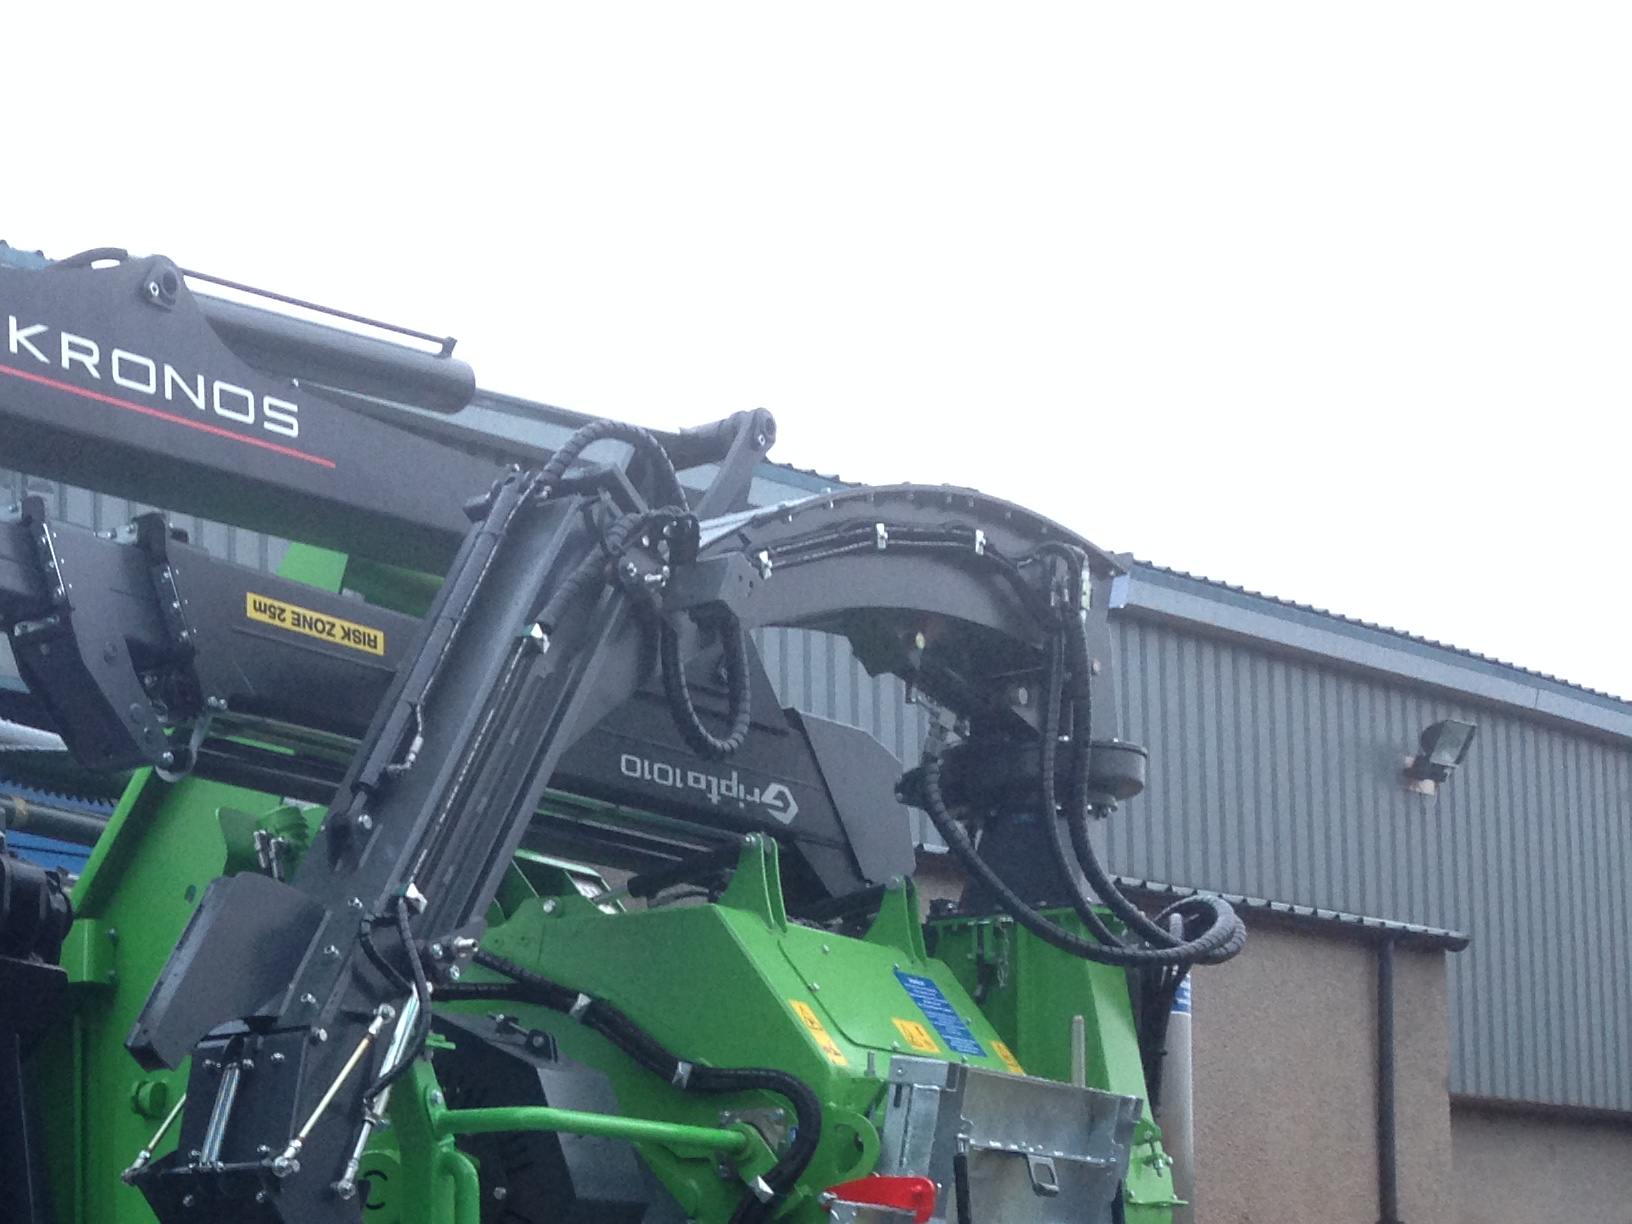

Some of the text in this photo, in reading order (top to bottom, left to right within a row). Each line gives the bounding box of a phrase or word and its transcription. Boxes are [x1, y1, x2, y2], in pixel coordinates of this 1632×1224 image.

[8, 315, 299, 437] KRONOS
[253, 599, 378, 649] RISK ZONE 25m
